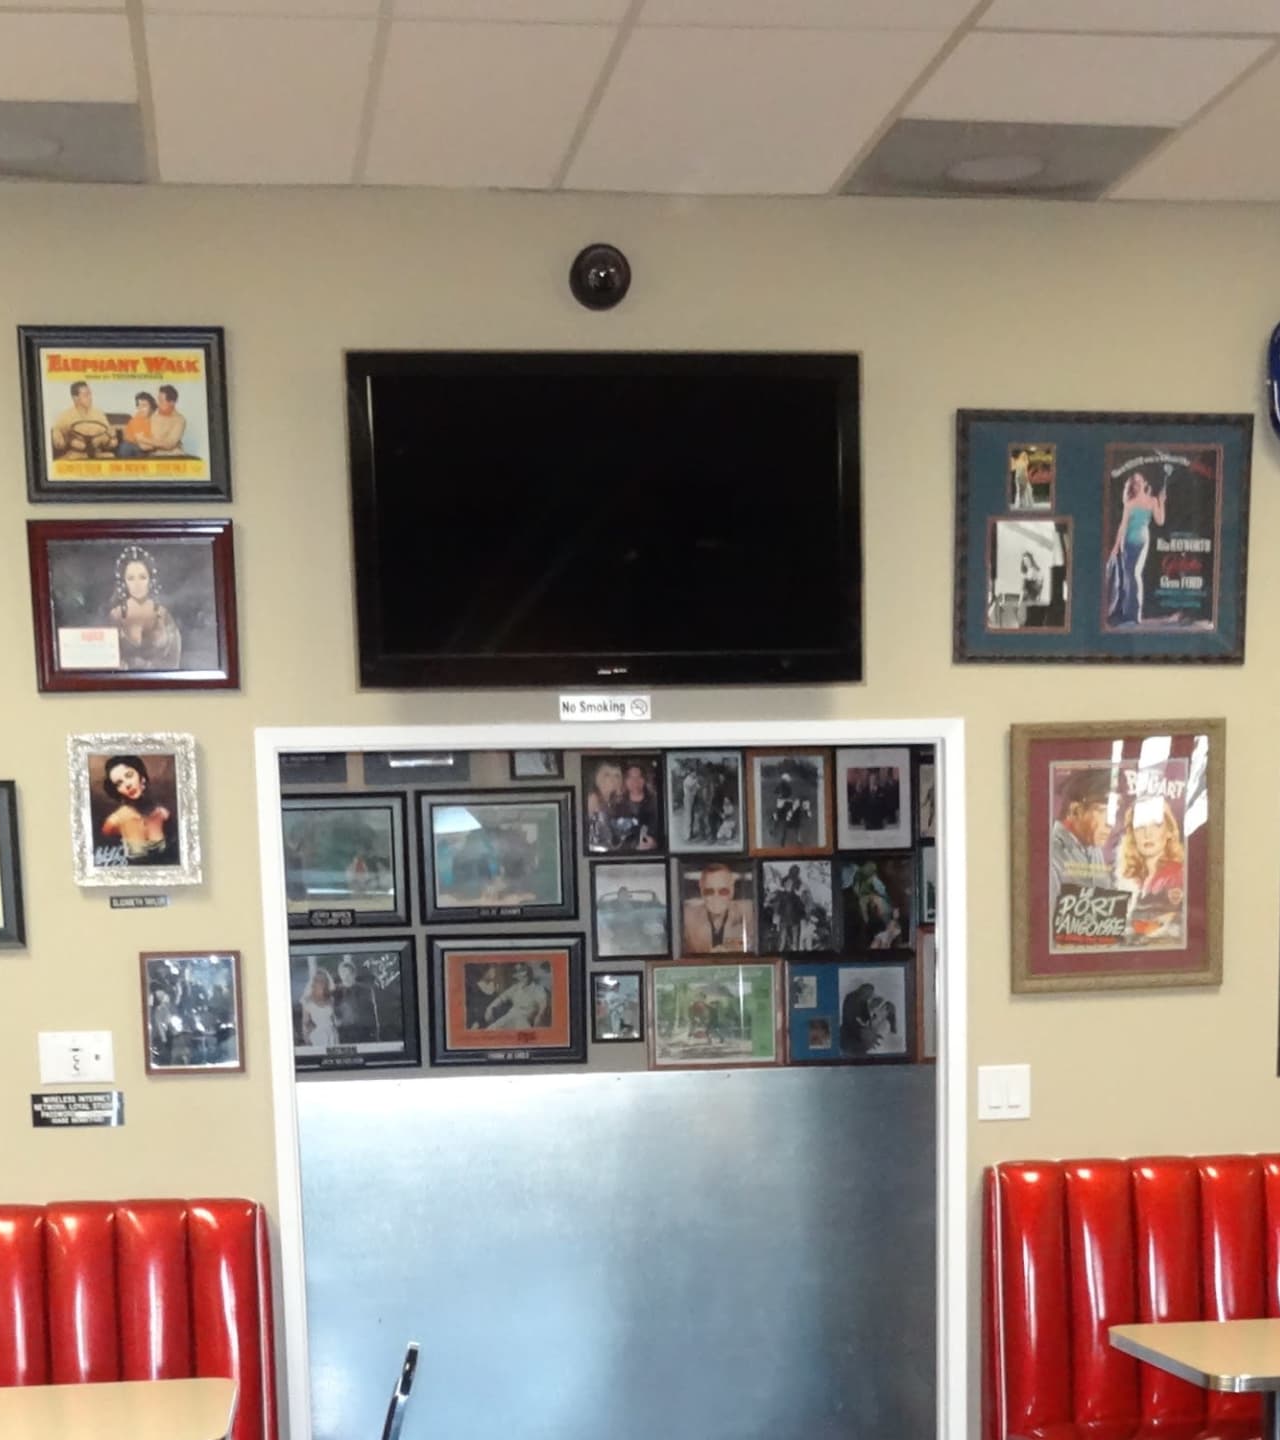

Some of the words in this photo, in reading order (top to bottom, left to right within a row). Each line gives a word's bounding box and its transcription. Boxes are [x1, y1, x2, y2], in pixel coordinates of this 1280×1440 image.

[47, 355, 140, 373] ELEPHANT
[143, 357, 199, 373] WALK
[562, 700, 576, 713] No
[580, 700, 626, 717] Smoking
[1124, 769, 1186, 799] BGART
[1059, 894, 1129, 916] PORT
